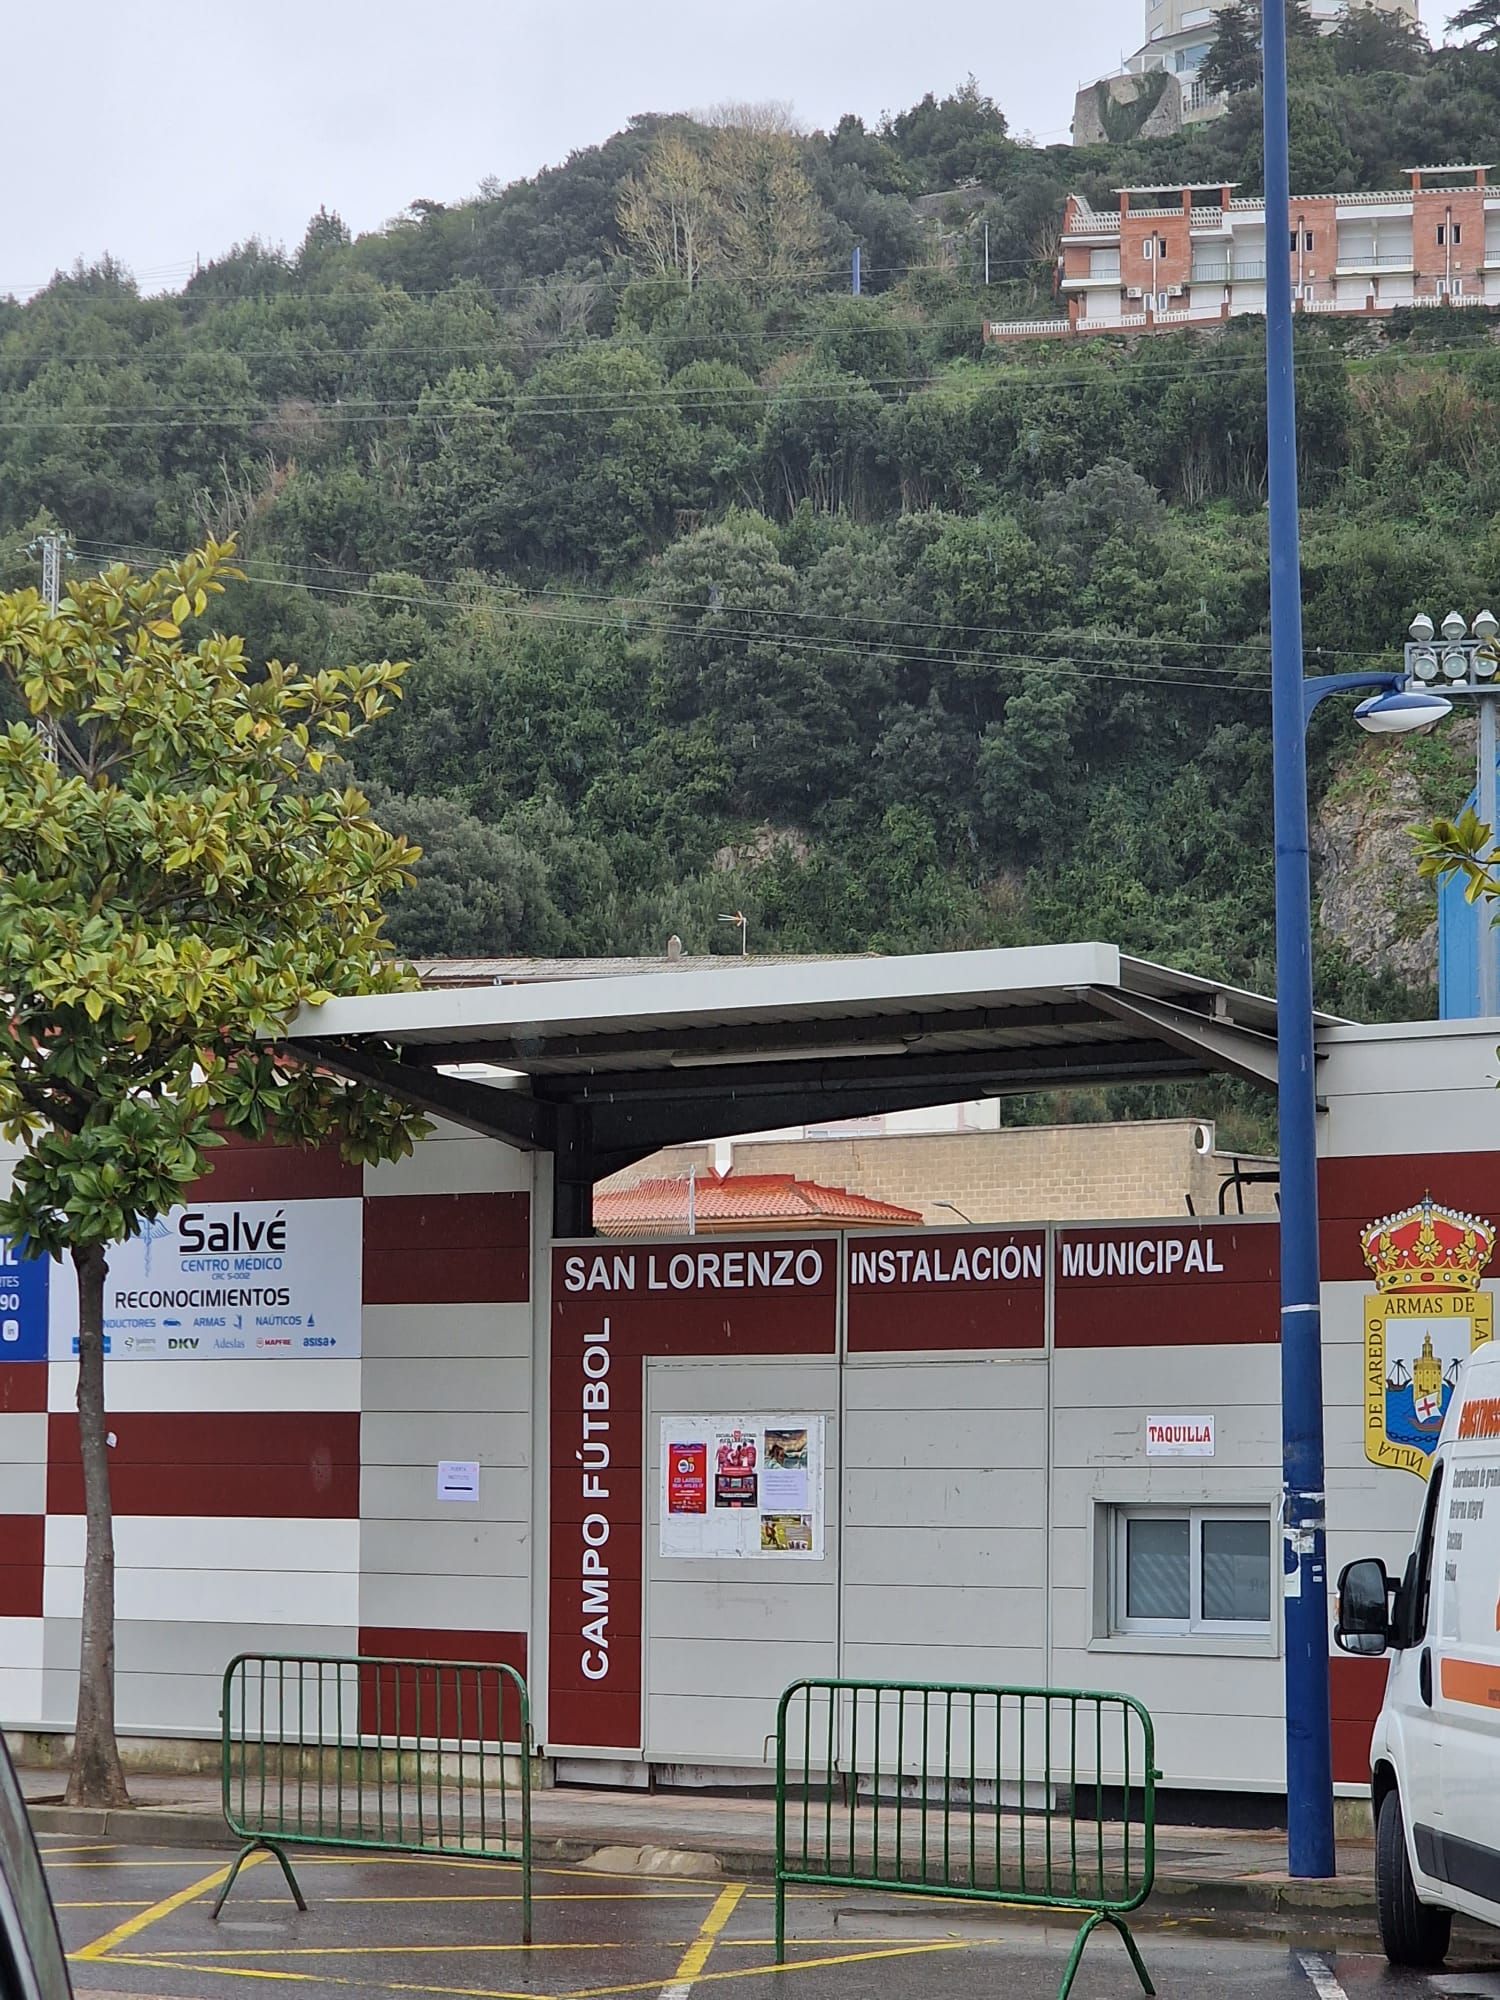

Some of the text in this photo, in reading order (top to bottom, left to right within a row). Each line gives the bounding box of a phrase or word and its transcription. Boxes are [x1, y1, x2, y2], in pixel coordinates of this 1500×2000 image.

[179, 1210, 286, 1252] Salvé
[181, 1259, 230, 1272] CENTRO
[851, 1237, 1041, 1284] INSTALACIÓN
[1062, 1238, 1223, 1277] MUNICIPAL
[564, 1249, 823, 1291] SAN LORENZO
[115, 1288, 290, 1309] RECONOCIMIENTOS
[1384, 1296, 1475, 1314] ARMAS DE
[103, 1315, 302, 1328] NDUCTORES ARMAS NAÚTICOS
[1475, 1318, 1488, 1341] LA
[168, 1338, 200, 1349] DKV
[213, 1337, 245, 1349] Adeslas
[303, 1337, 329, 1347] asisa
[1369, 1319, 1383, 1428] DE LAREDO
[1149, 1426, 1211, 1443] TAQUILLA
[1378, 1441, 1424, 1472] VILLA
[576, 1317, 610, 1680] CAMPO FÚTBOL
